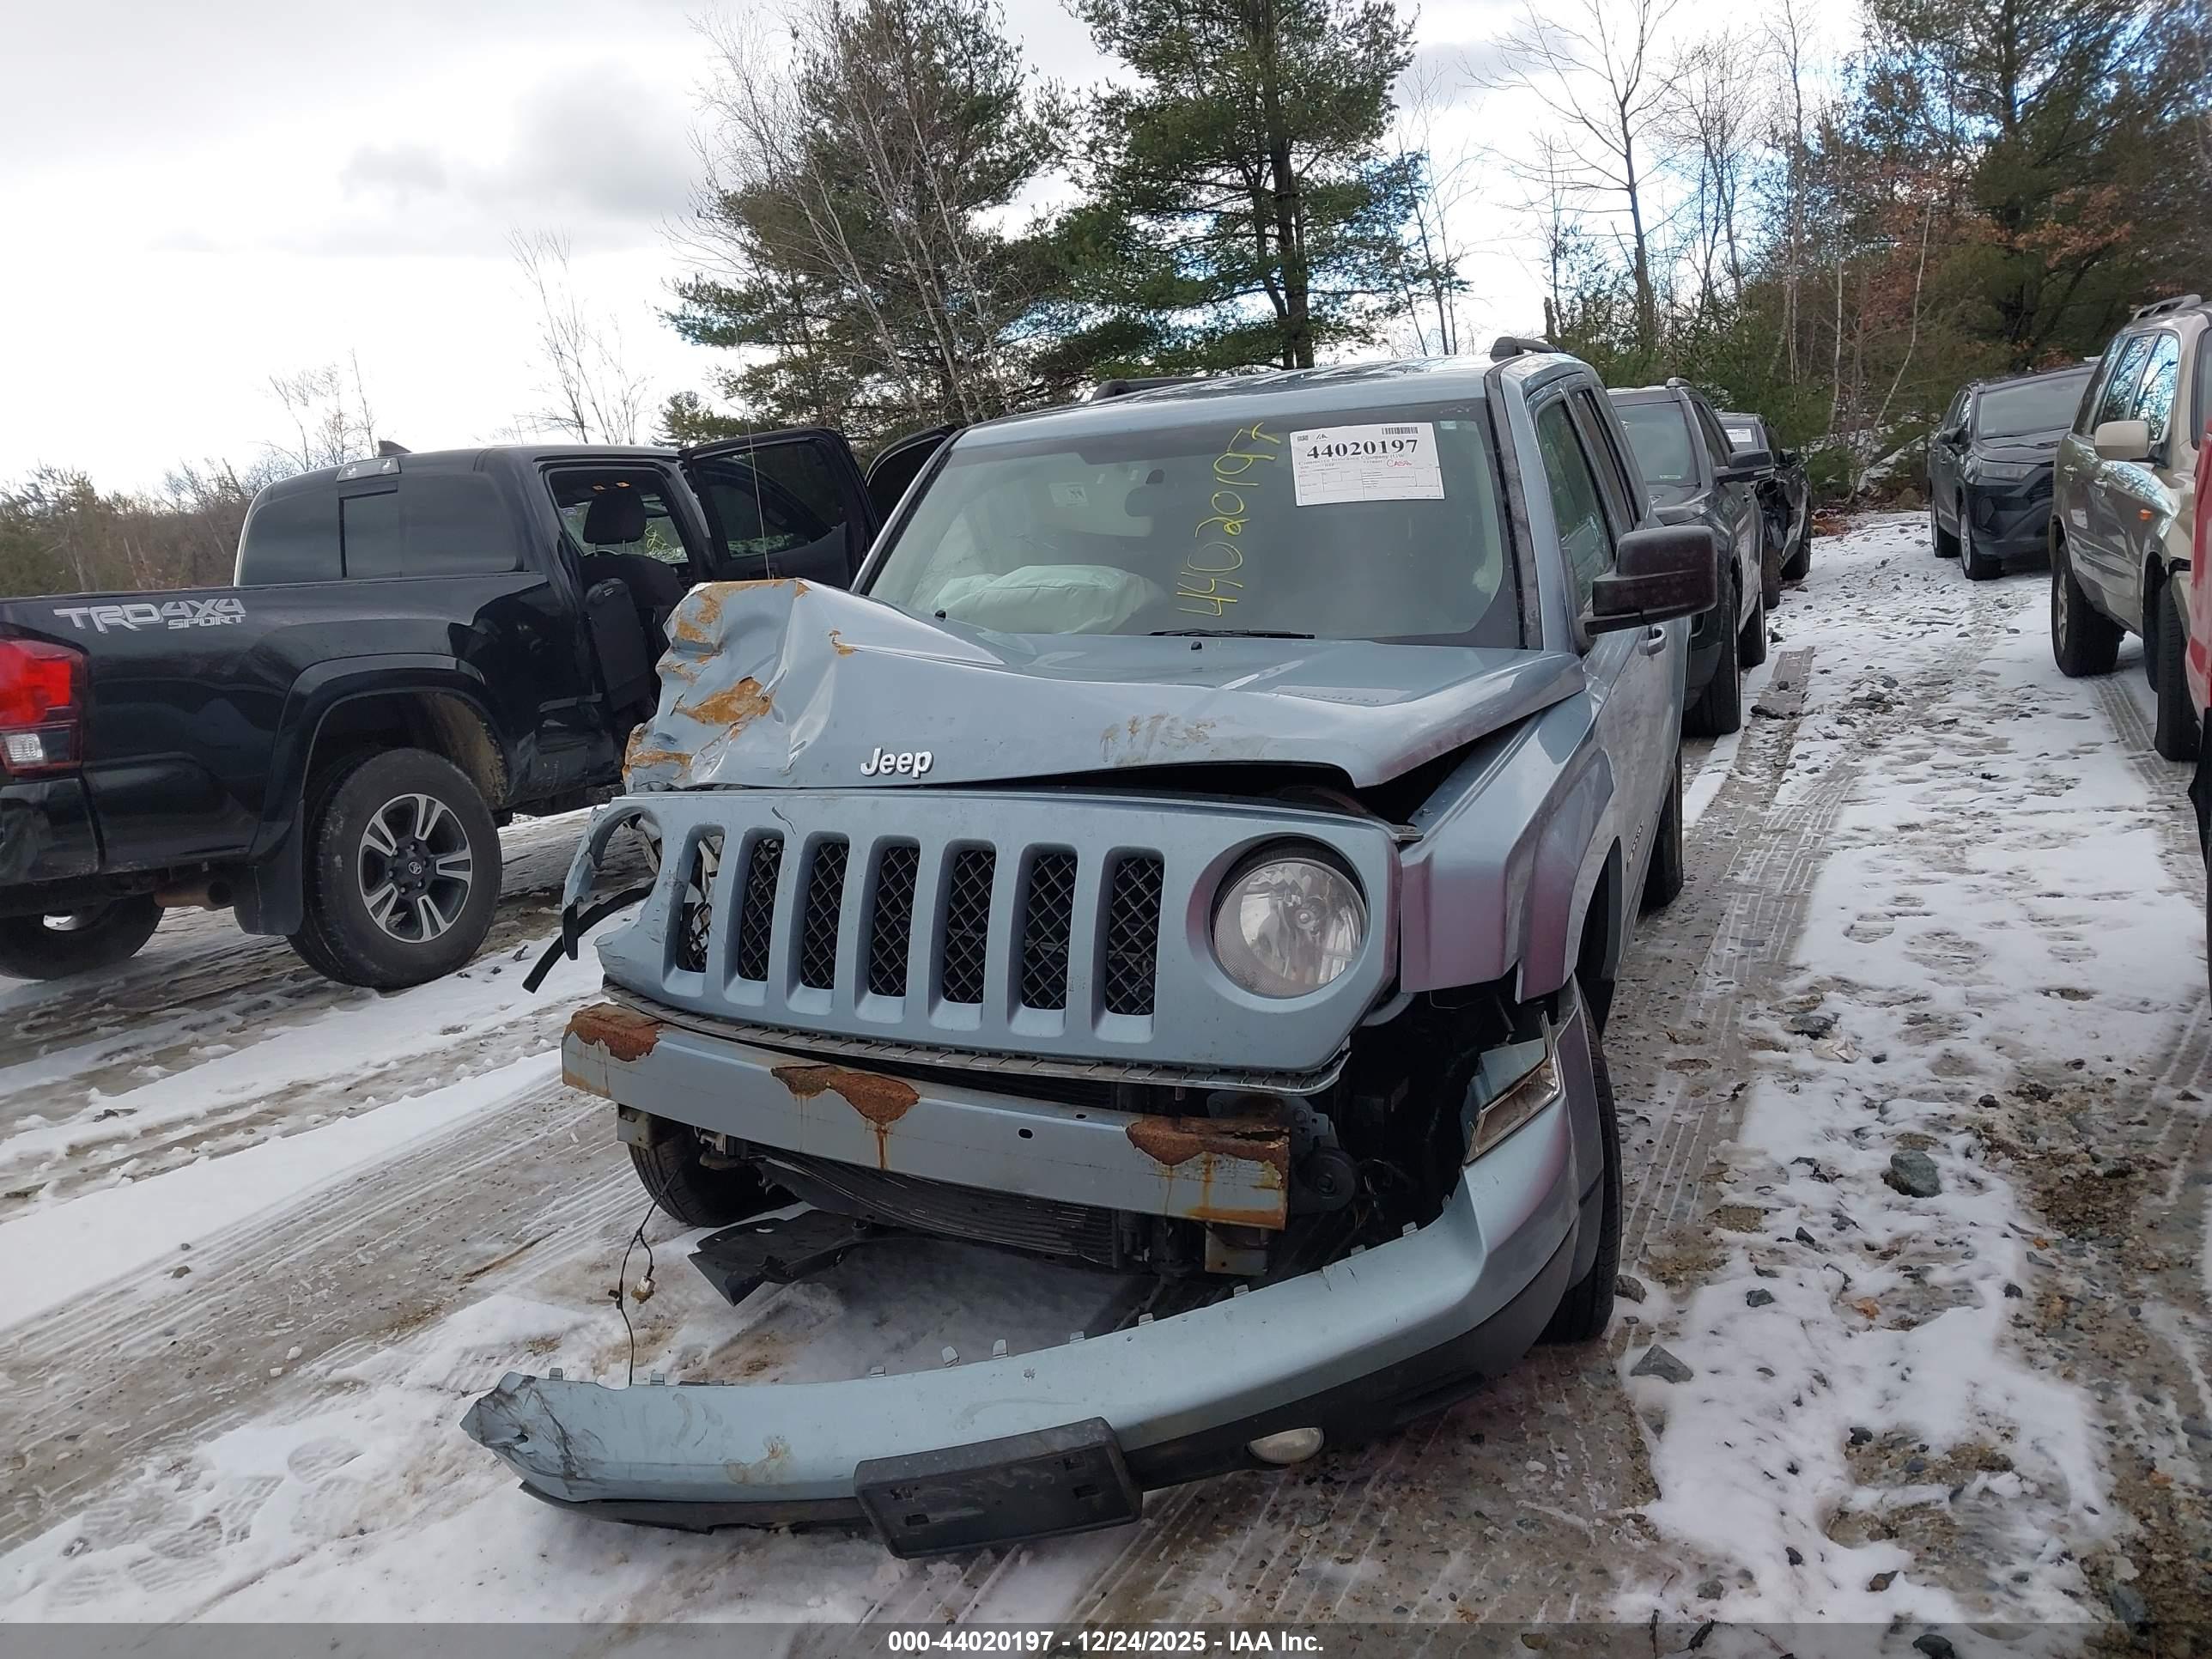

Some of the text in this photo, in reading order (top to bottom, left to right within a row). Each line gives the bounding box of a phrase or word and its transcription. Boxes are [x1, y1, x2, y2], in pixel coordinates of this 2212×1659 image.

[1307, 439, 1419, 459] 44020197
[53, 603, 163, 634] TRD
[168, 614, 246, 629] SPORT
[860, 746, 933, 779] Jeep
